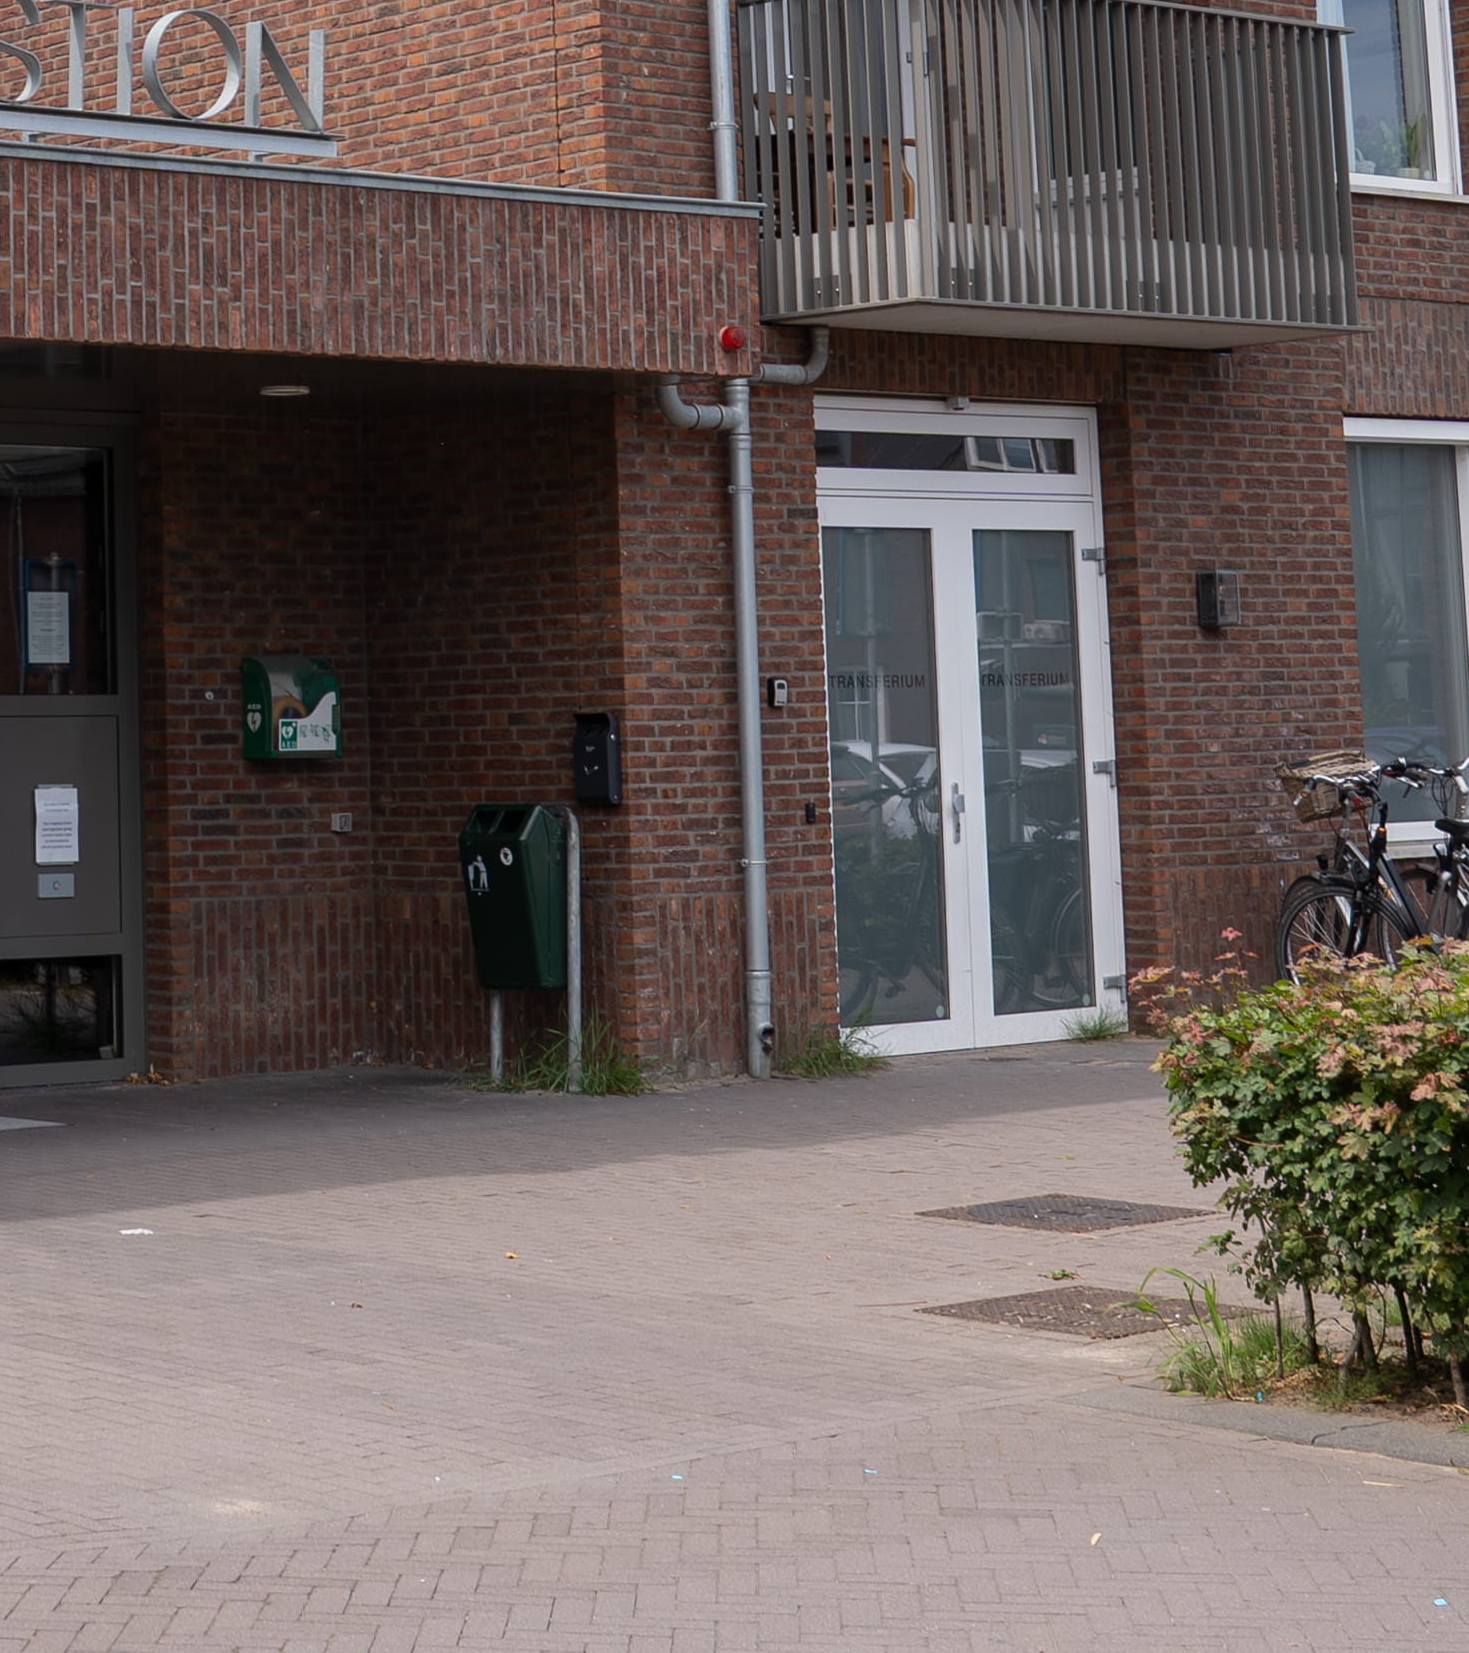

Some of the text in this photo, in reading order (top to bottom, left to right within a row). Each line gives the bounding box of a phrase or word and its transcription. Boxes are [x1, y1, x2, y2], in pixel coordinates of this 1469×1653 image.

[828, 674, 925, 689] TRANSFERIUM
[981, 673, 1069, 687] TRANSFERIUM
[281, 740, 297, 748] AED
